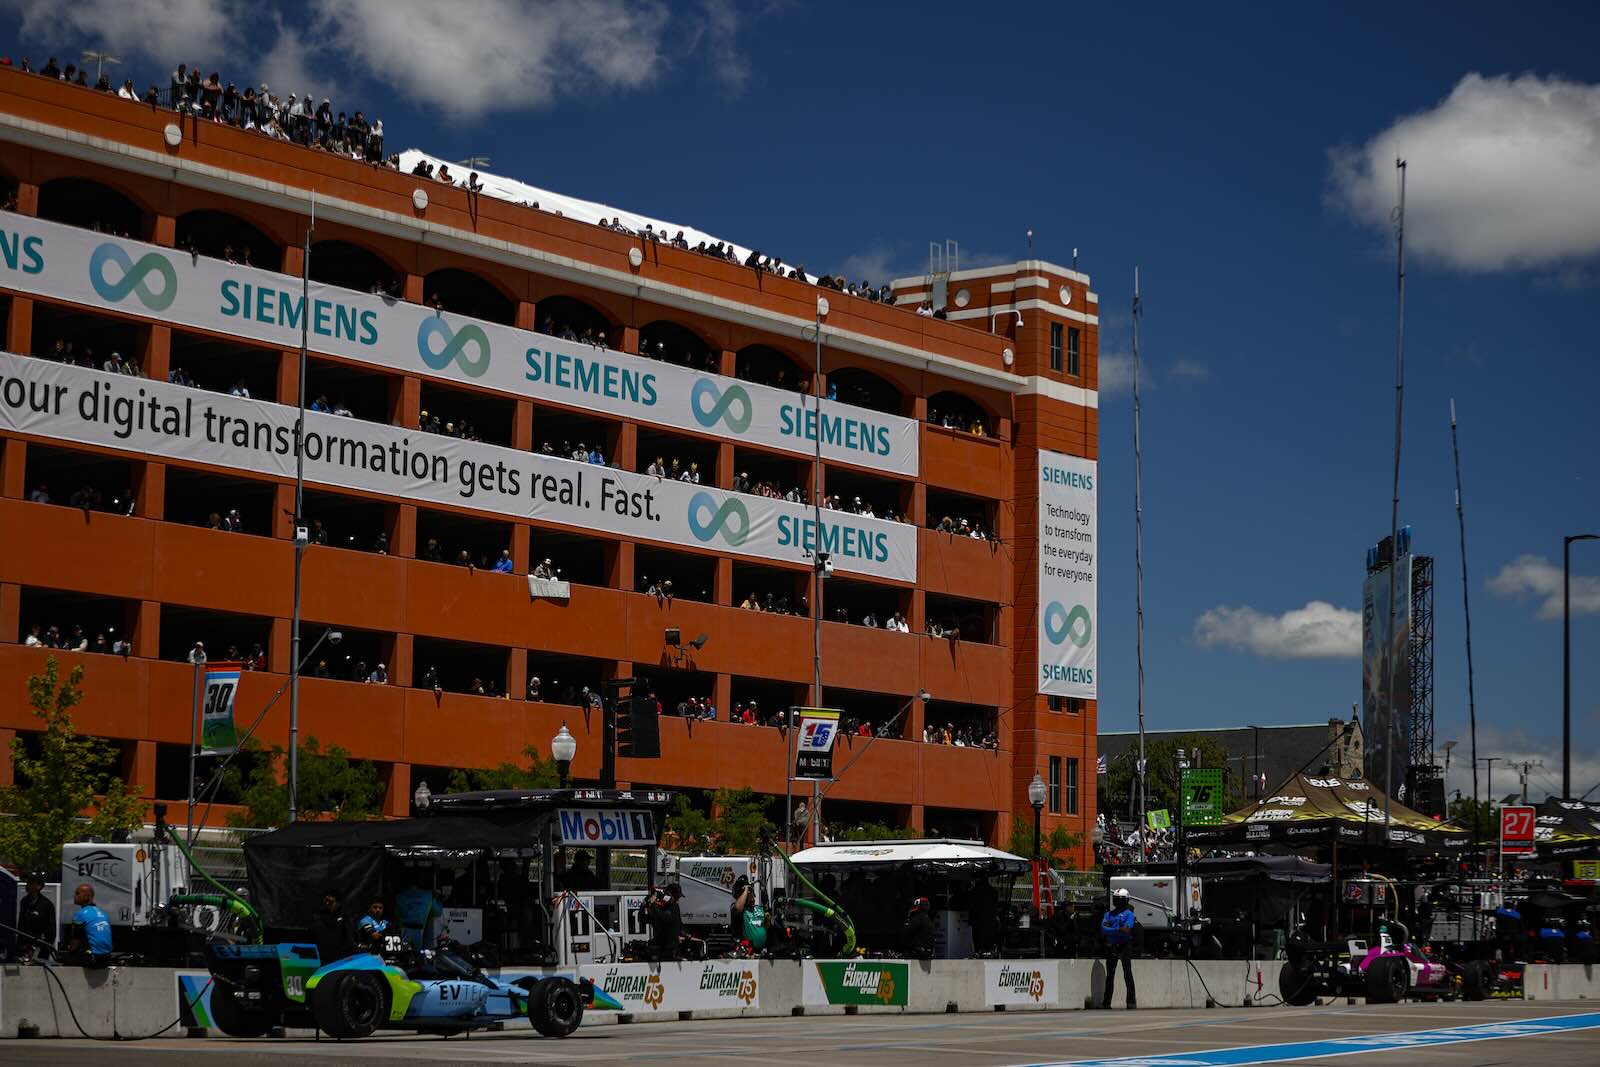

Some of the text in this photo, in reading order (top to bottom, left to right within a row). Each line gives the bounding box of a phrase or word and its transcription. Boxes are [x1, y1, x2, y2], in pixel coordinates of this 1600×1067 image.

[220, 279, 378, 345] SIEMENS
[525, 348, 657, 406] SIEMENS
[780, 405, 890, 456] SIEMENS
[0, 375, 660, 522] our digital transformation gets real. Fast.
[1043, 466, 1093, 490] SIEMENS
[1046, 504, 1090, 525] Technology
[777, 515, 889, 562] SIEMENS
[1045, 524, 1092, 543] to transform
[1044, 544, 1093, 566] the everyday
[1044, 563, 1092, 583] for everyone
[1042, 664, 1093, 685] SIEMENS
[205, 683, 234, 713] 30
[803, 723, 833, 747] 15
[560, 810, 630, 840] Mobil
[1504, 812, 1532, 835] 27
[79, 863, 119, 877] EVTEC
[691, 866, 723, 878] CURRAN
[606, 968, 617, 976] JJ
[703, 965, 713, 973] JJ
[846, 963, 856, 971] JJ
[604, 976, 647, 993] CURRAN
[700, 972, 741, 990] CURRAN
[842, 971, 881, 987] CURRAN
[999, 972, 1031, 987] CURRAN
